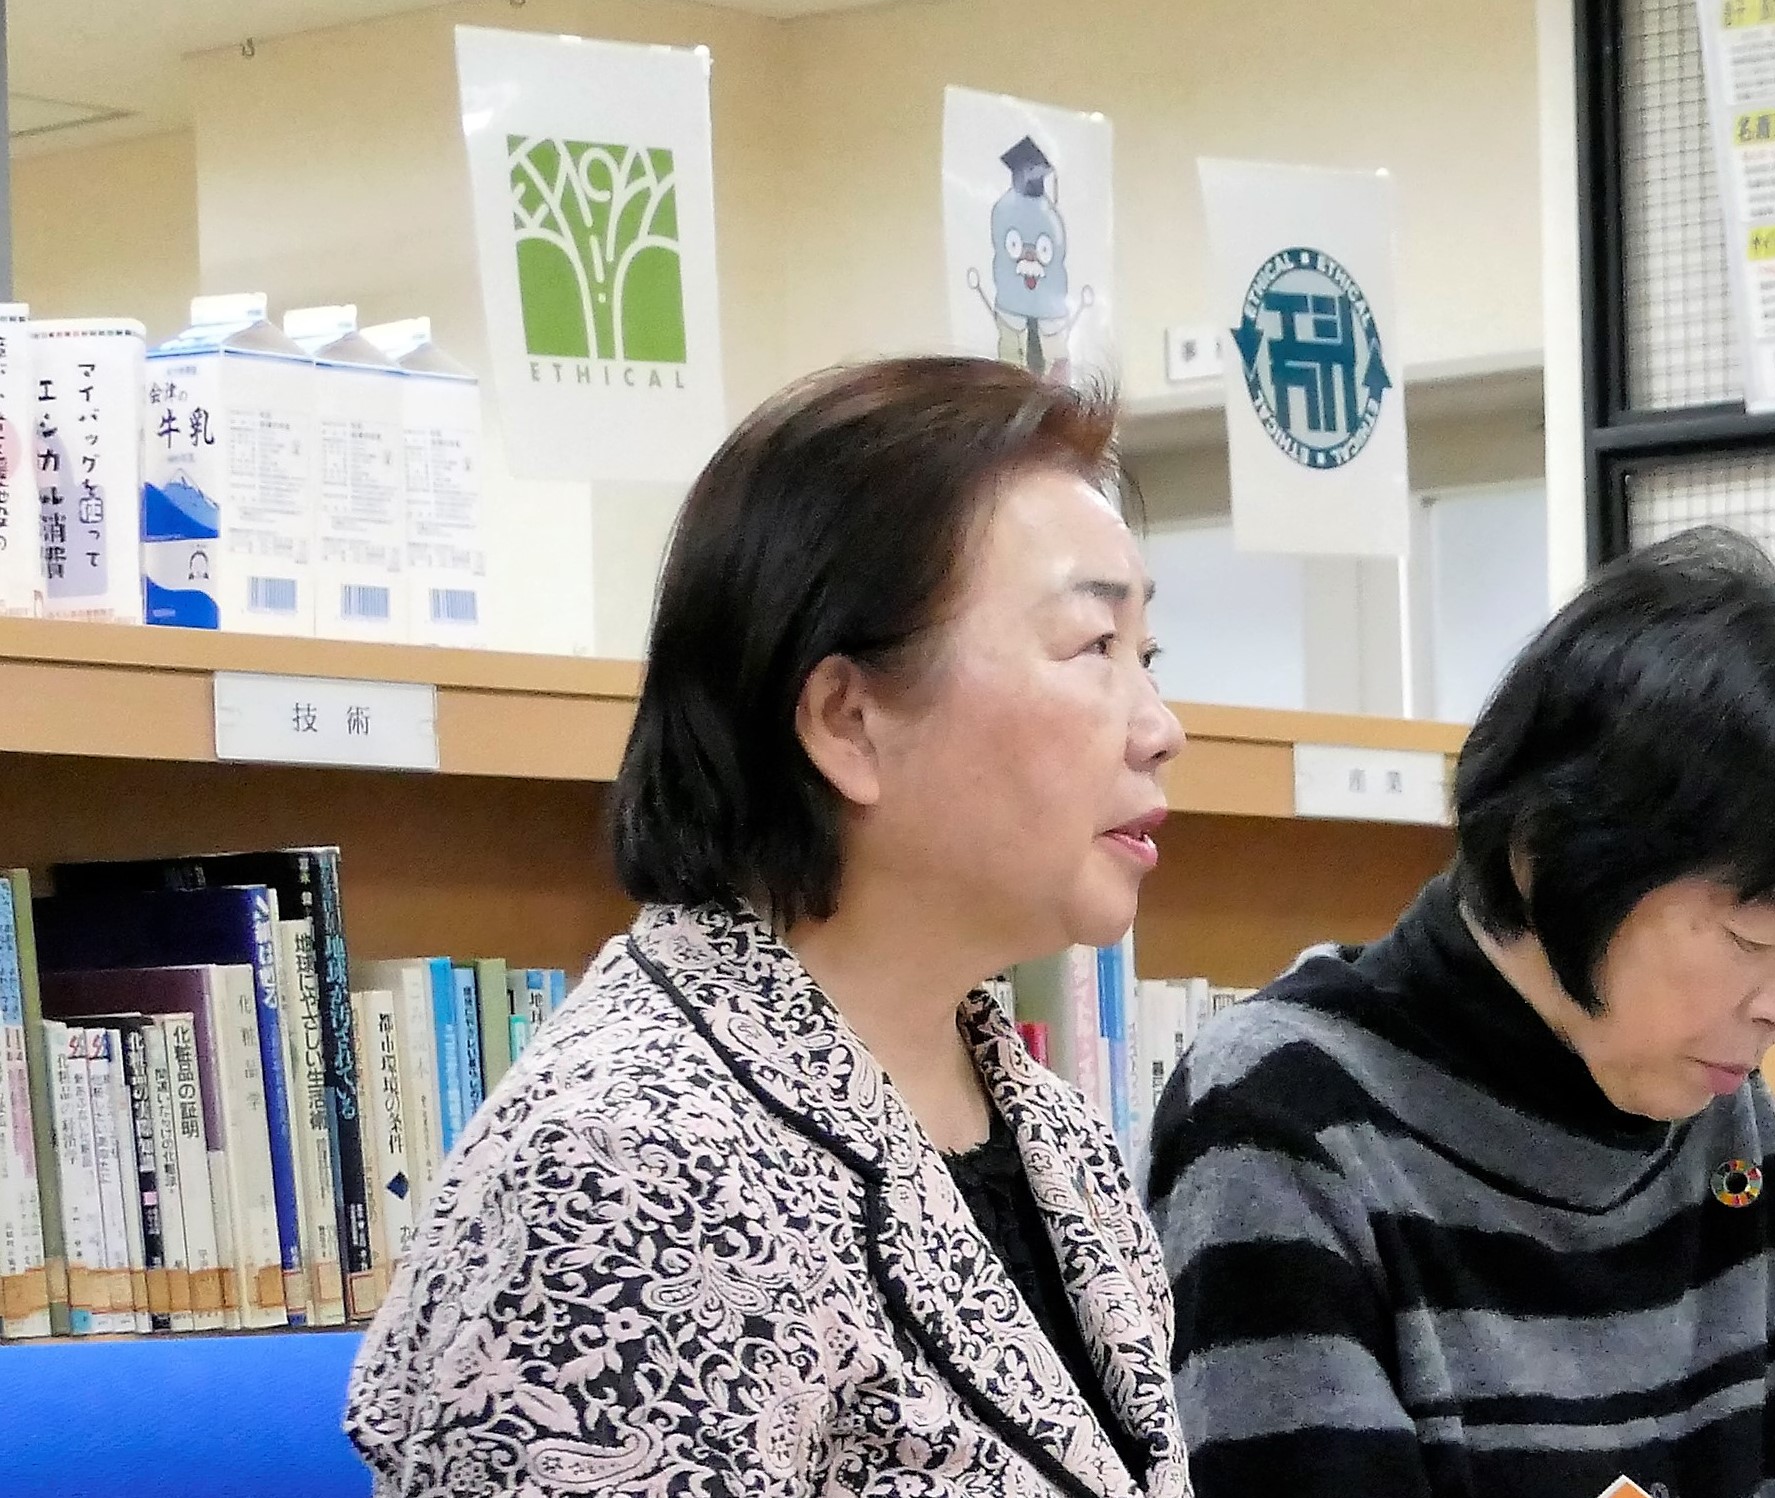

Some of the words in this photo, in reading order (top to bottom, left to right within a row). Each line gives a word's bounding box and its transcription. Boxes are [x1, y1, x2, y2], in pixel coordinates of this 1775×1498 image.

[530, 361, 685, 390] ETHICAL
[157, 407, 215, 449] 牛乳
[78, 362, 104, 567] マイバッグを使って
[292, 702, 370, 735] 技術
